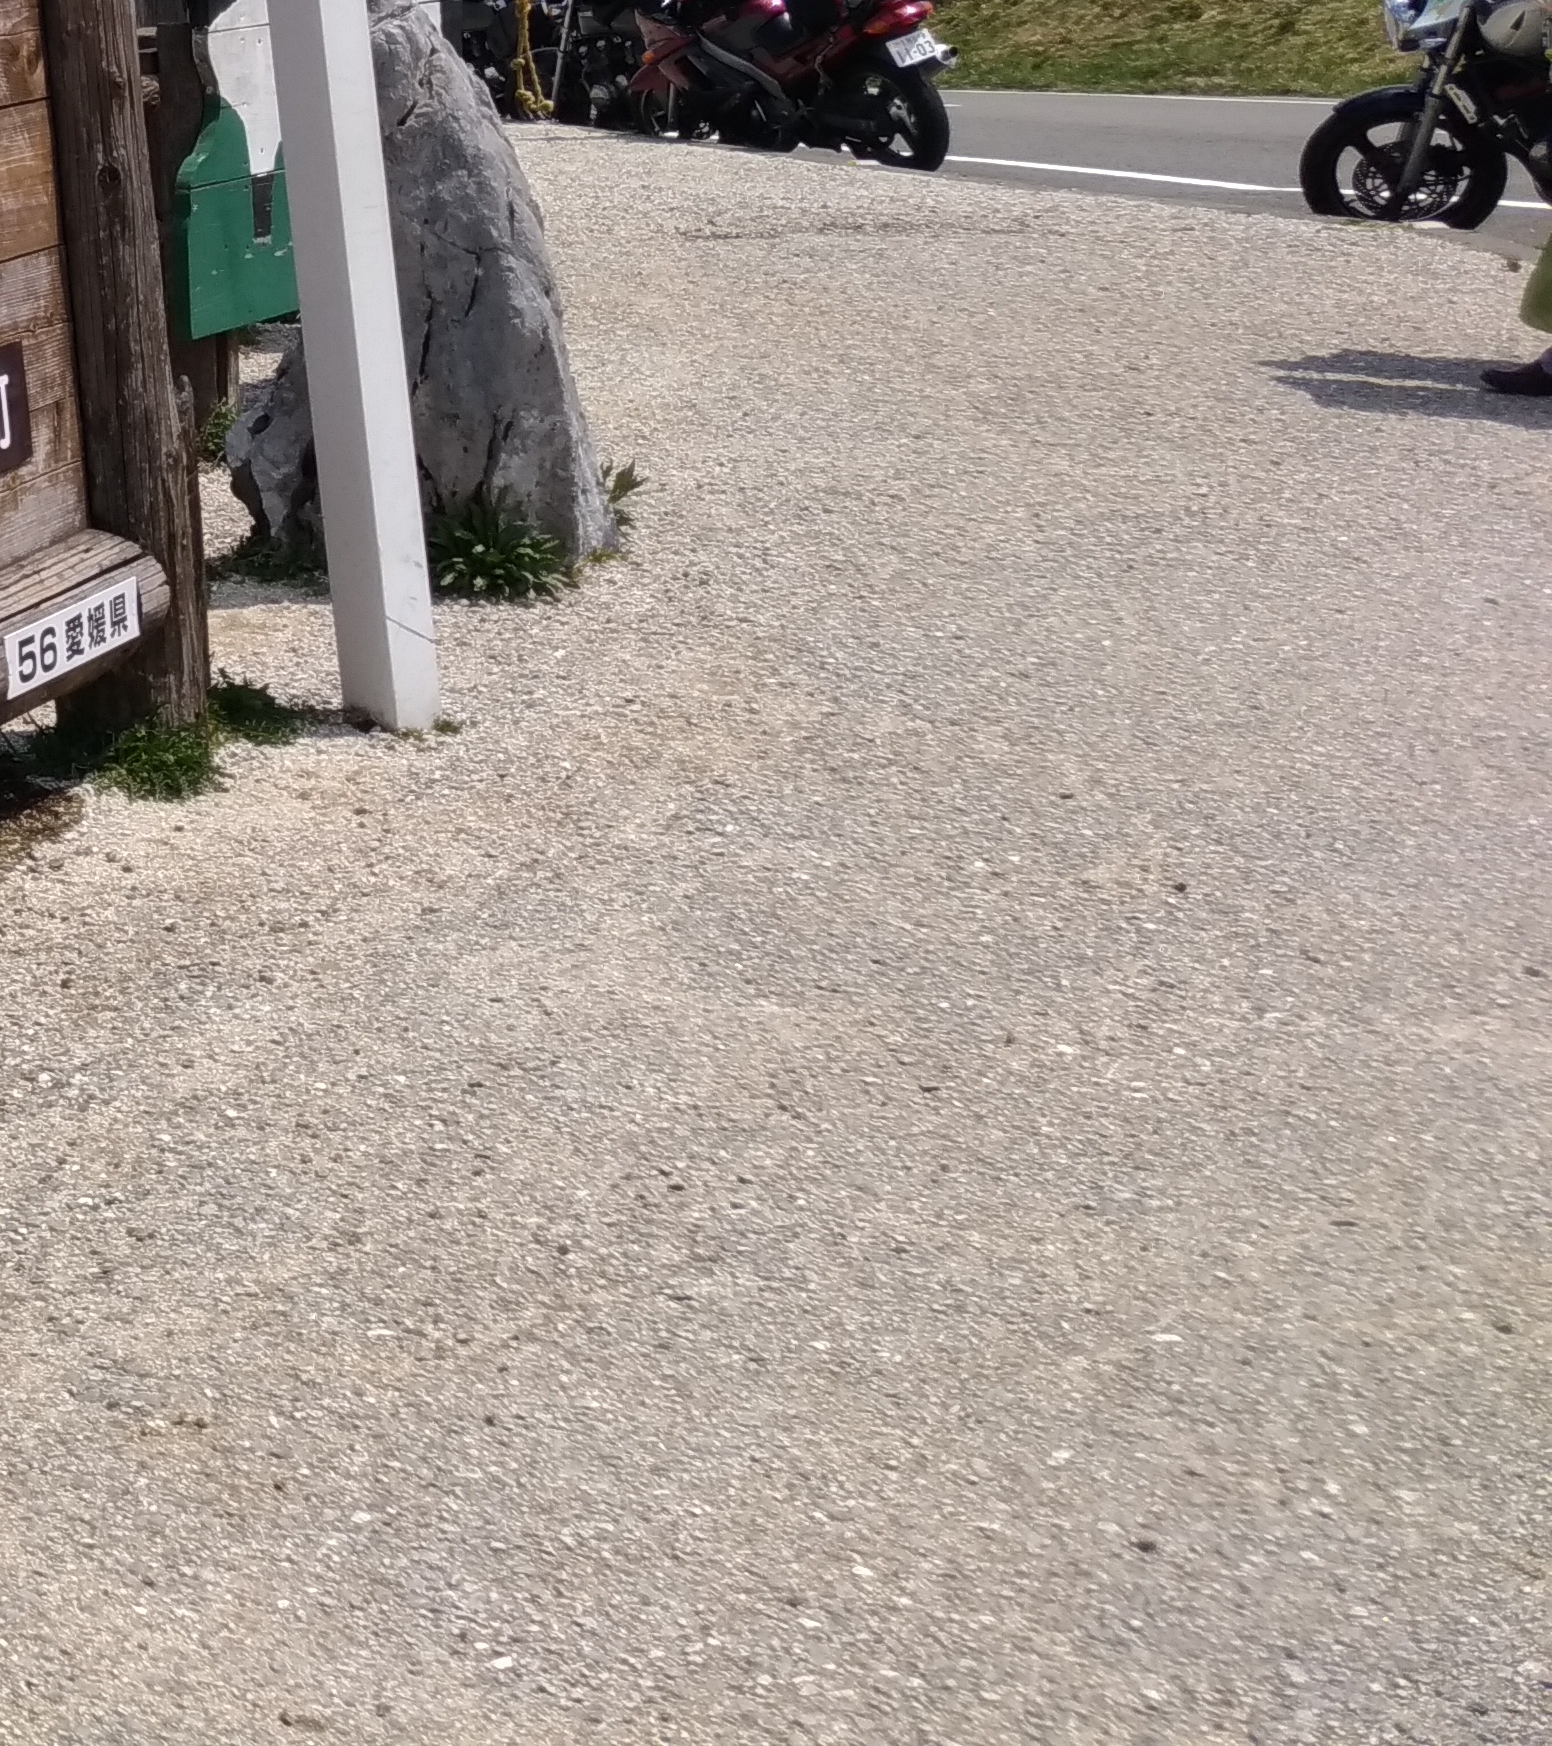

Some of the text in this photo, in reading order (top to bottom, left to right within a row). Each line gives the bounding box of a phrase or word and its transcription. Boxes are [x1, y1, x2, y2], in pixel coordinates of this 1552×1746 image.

[18, 592, 128, 684] 56 愛媛県
